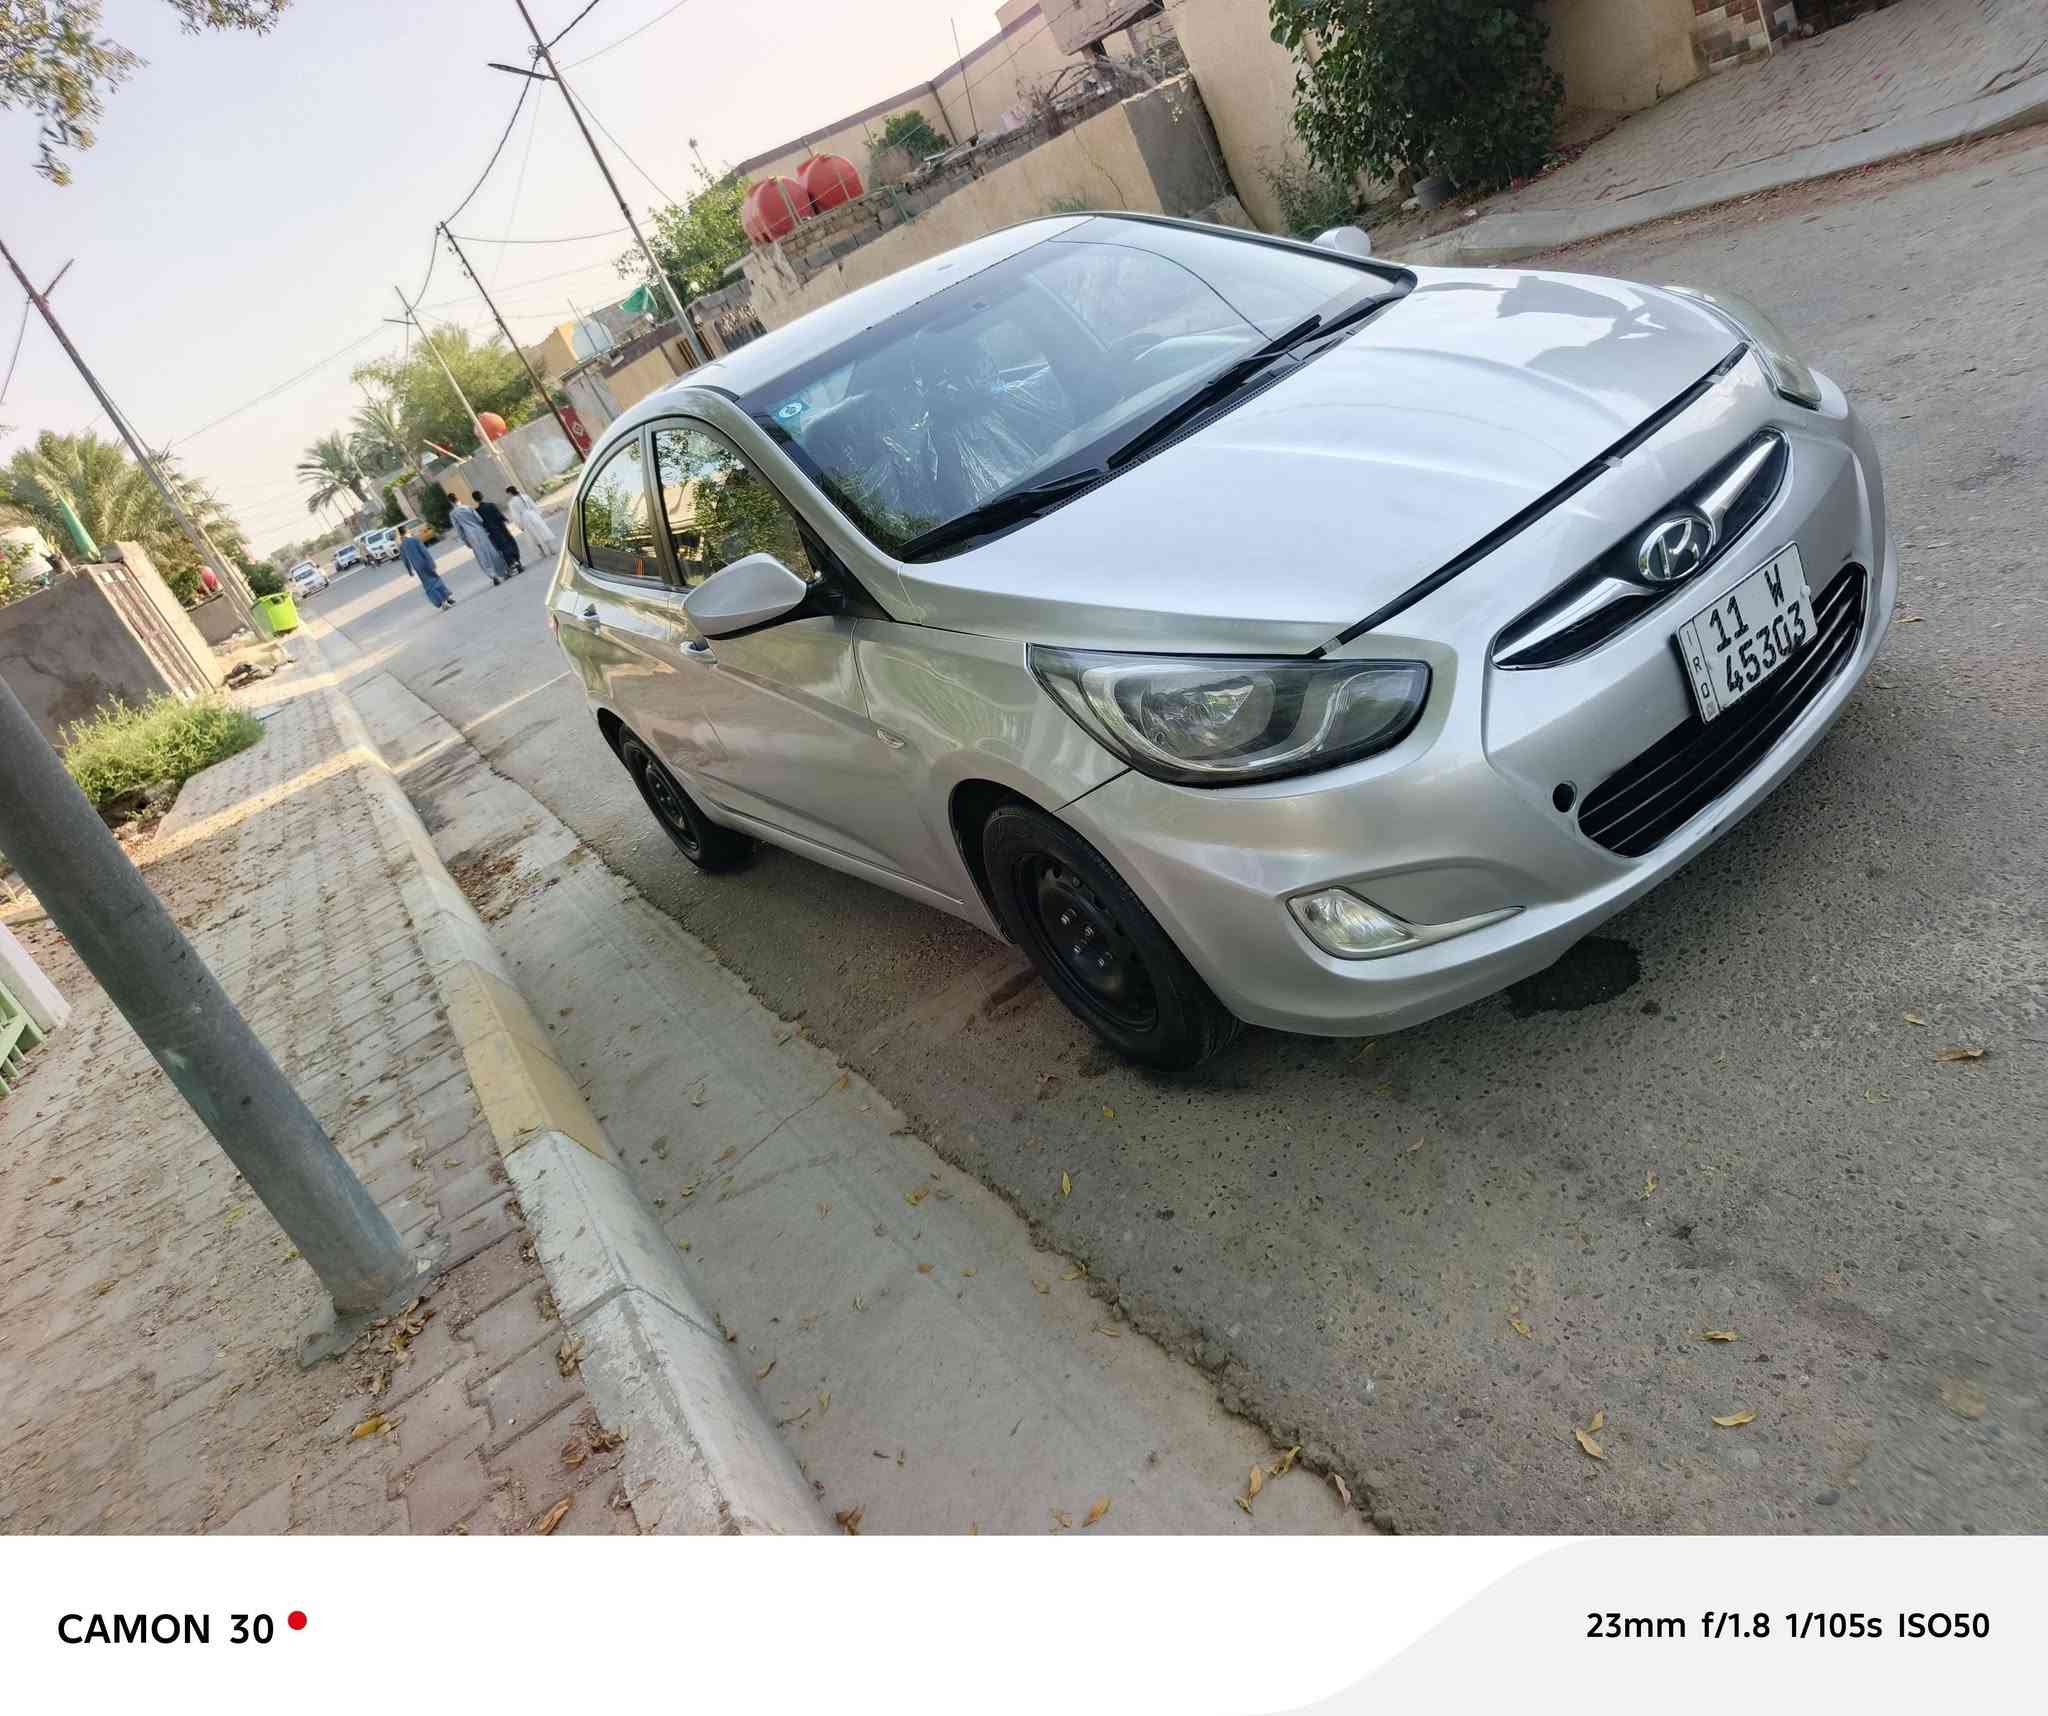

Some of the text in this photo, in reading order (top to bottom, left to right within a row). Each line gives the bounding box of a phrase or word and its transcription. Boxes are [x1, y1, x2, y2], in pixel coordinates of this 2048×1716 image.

[1709, 563, 1785, 653] 11 W
[1726, 600, 1807, 692] 45303
